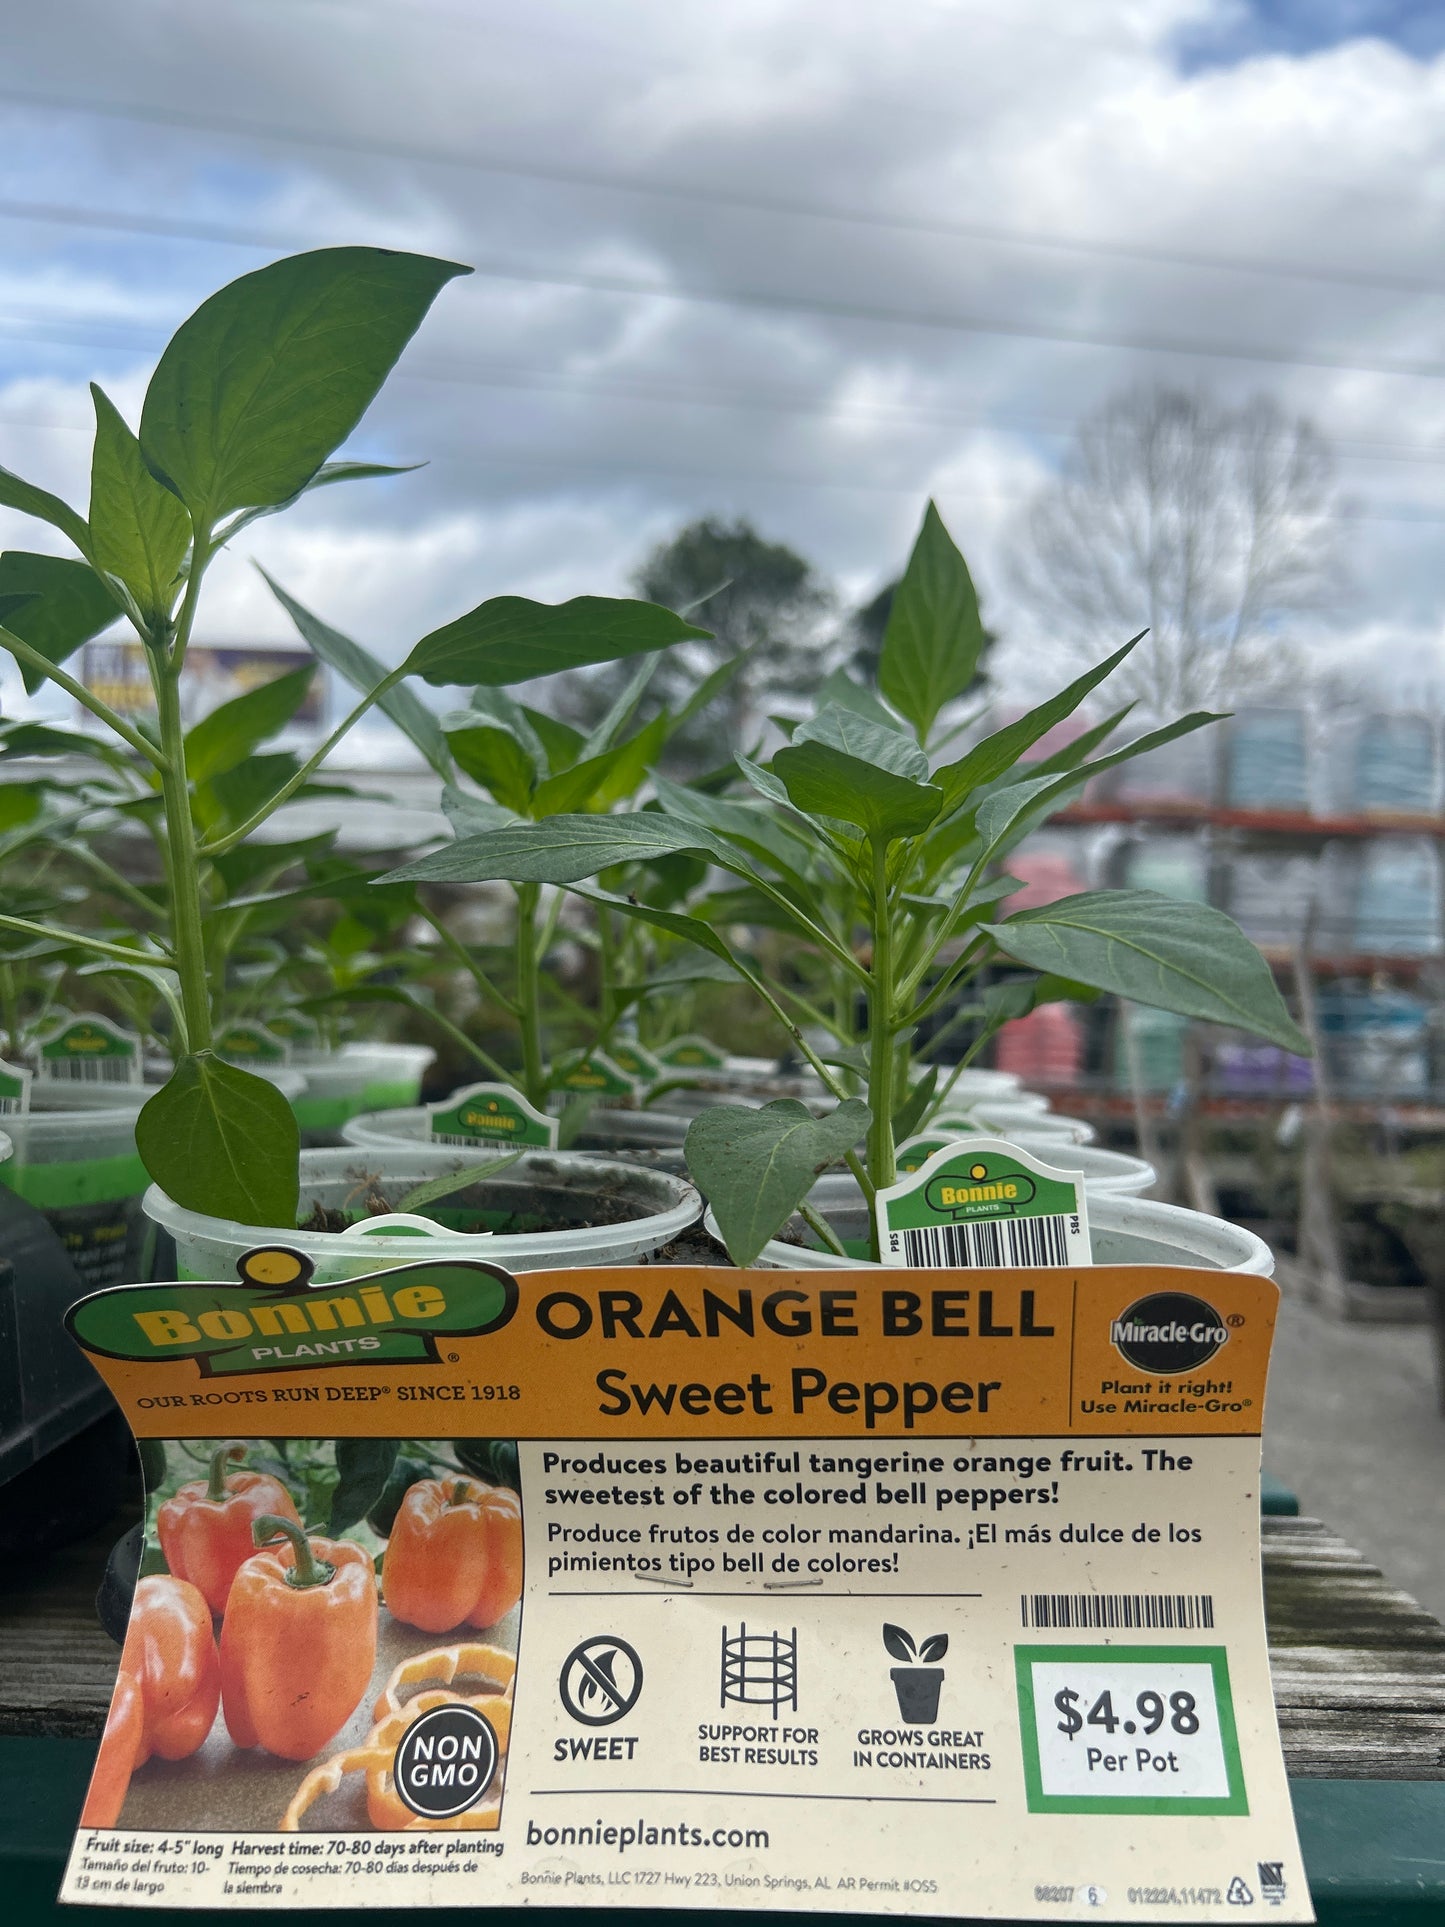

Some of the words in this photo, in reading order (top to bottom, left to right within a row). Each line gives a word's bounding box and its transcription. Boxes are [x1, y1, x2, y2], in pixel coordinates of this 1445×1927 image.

[941, 1182, 1018, 1205] Bonnie
[966, 1203, 1000, 1213] PLANTS
[1069, 1215, 1080, 1235] PBS
[890, 1232, 900, 1252] PBS
[134, 1285, 446, 1346] Bonnie
[536, 1288, 859, 1340] ORANGE
[882, 1290, 1055, 1337] BELL
[252, 1336, 382, 1361] PLANTS
[137, 1396, 188, 1409] OUR
[192, 1389, 268, 1406] ROOTS
[273, 1387, 320, 1403] RUN
[397, 1385, 465, 1401] SINCE
[471, 1385, 521, 1401] 1918
[596, 1368, 774, 1416] Sweet
[791, 1367, 1002, 1429] Pepper
[1101, 1380, 1152, 1395] Plant
[1158, 1380, 1172, 1394] it
[1178, 1379, 1233, 1397] right!
[1080, 1400, 1117, 1414] Use
[543, 1452, 667, 1474] Produces
[675, 1451, 800, 1474] beautiful
[809, 1451, 944, 1479] tangerine
[953, 1454, 1051, 1478] orange
[1060, 1450, 1134, 1472] fruit.
[1141, 1449, 1193, 1471] The
[545, 1484, 665, 1506] sweetest
[673, 1483, 702, 1505] of
[710, 1483, 755, 1505] the
[763, 1482, 867, 1505] colored
[875, 1482, 926, 1505] bell
[935, 1481, 1059, 1511] peppers!
[548, 1522, 642, 1543] Produce
[648, 1523, 720, 1544] frutos
[726, 1523, 755, 1544] de
[762, 1523, 822, 1544] color
[828, 1523, 961, 1544] mandarina.
[967, 1522, 997, 1550] ¡El
[1005, 1523, 1051, 1543] más
[1059, 1522, 1125, 1544] dulce
[1131, 1522, 1161, 1544] de
[1168, 1522, 1202, 1544] los
[549, 1550, 662, 1578] pimientos
[669, 1551, 715, 1578] tipo
[722, 1552, 764, 1573] bell
[771, 1552, 801, 1573] de
[807, 1552, 900, 1574] colores!
[1053, 1686, 1200, 1742] $4.98
[698, 1724, 779, 1744] SUPPORT
[782, 1726, 820, 1745] FOR
[857, 1729, 924, 1748] GROWS
[927, 1730, 984, 1748] GREAT
[413, 1735, 483, 1760] NON
[553, 1736, 640, 1762] SWEET
[699, 1746, 741, 1764] BEST
[744, 1746, 819, 1766] RESULTS
[853, 1751, 873, 1768] IN
[876, 1751, 991, 1770] CONTAINERS
[1086, 1747, 1128, 1772] Per
[1135, 1747, 1180, 1772] Pot
[410, 1763, 479, 1787] GMO
[526, 1818, 770, 1853] bonnieplants.com
[85, 1836, 121, 1852] Fruit
[123, 1838, 154, 1853] size:
[193, 1839, 224, 1859] long
[231, 1840, 285, 1856] Harvest
[288, 1841, 324, 1855] time:
[327, 1840, 372, 1855] 70-80
[374, 1840, 406, 1859] days
[408, 1839, 443, 1855] after
[445, 1838, 505, 1858] planting
[81, 1857, 129, 1871] Tamaño
[131, 1859, 152, 1872] del
[153, 1860, 188, 1874] fruto:
[191, 1860, 210, 1874] 10-
[228, 1861, 271, 1877] Tiempo
[273, 1862, 289, 1875] de
[292, 1861, 342, 1874] cosecha:
[344, 1861, 383, 1874] 70-80
[412, 1859, 460, 1876] después
[463, 1859, 478, 1873] de
[92, 1879, 112, 1890] cm
[114, 1877, 131, 1891] de
[133, 1878, 165, 1895] largo
[223, 1881, 233, 1894] la
[236, 1880, 283, 1894] siembra
[521, 1871, 562, 1885] Bonnie
[565, 1871, 604, 1886] Plants,
[608, 1871, 631, 1885] LLC
[634, 1872, 661, 1885] 1727
[664, 1872, 692, 1889] Hwy
[694, 1872, 721, 1887] 223,
[725, 1873, 761, 1887] Union
[764, 1874, 811, 1891] Springs,
[814, 1876, 831, 1890] AL
[837, 1877, 856, 1890] AR
[859, 1878, 900, 1892] Permit
